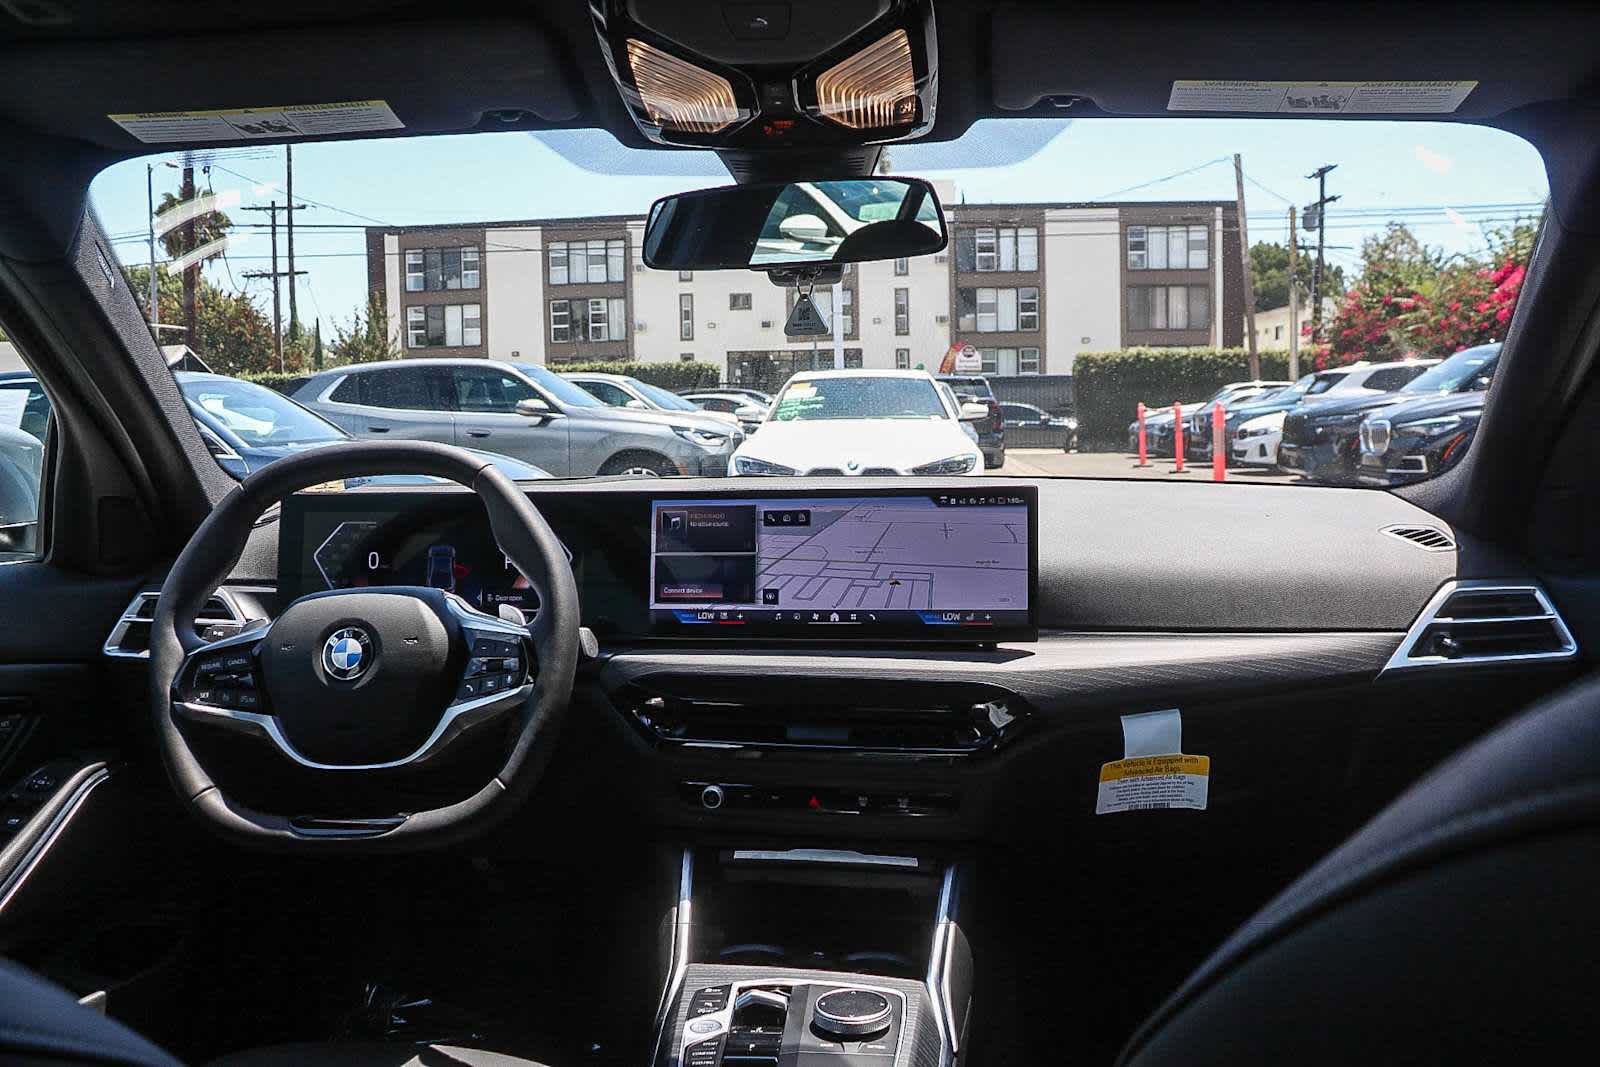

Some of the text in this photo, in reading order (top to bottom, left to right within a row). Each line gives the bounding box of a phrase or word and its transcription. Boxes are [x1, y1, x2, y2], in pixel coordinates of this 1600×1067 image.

[368, 551, 379, 569] 0
[697, 612, 715, 620] LOW
[942, 613, 961, 621] LOW
[1152, 757, 1183, 766] Equipped
